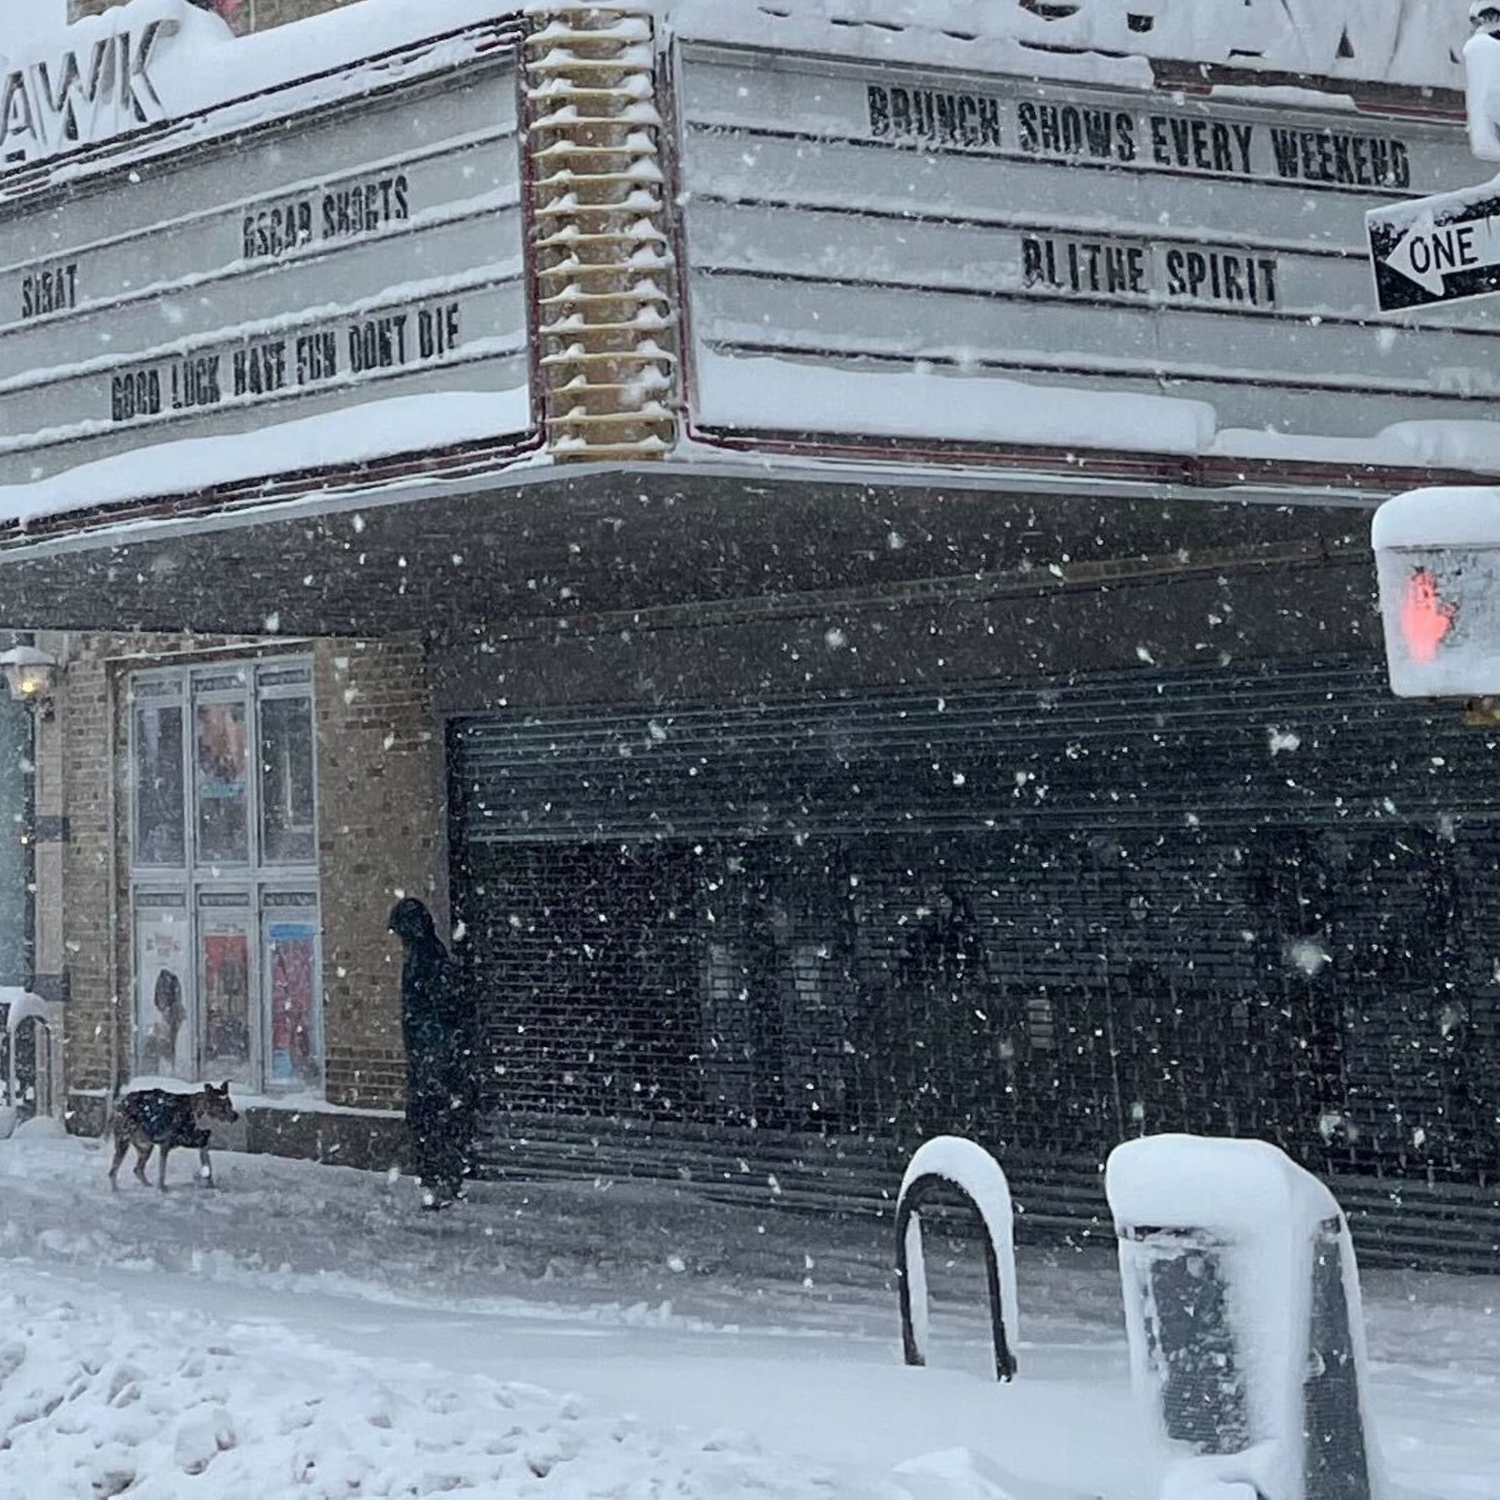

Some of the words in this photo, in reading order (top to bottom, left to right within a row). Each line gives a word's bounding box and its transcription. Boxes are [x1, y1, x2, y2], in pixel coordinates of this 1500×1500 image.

[867, 85, 1000, 148] BRUNCH
[1017, 100, 1137, 163] SHOWS
[1150, 114, 1255, 175] EVERY
[1269, 127, 1412, 190] WEEKEND
[243, 200, 312, 259] OSCAR
[322, 174, 409, 240] SHORTS
[1409, 226, 1480, 275] ONE
[21, 262, 78, 319] SIRAT
[1022, 236, 1147, 294] BLITHE
[1166, 248, 1279, 307] SPIRIT
[111, 368, 161, 422] GOOD
[171, 355, 221, 410] LUCK
[232, 339, 287, 397] HAVE
[296, 330, 338, 386] FUN
[348, 313, 408, 374] DONT
[418, 301, 461, 360] DIE
